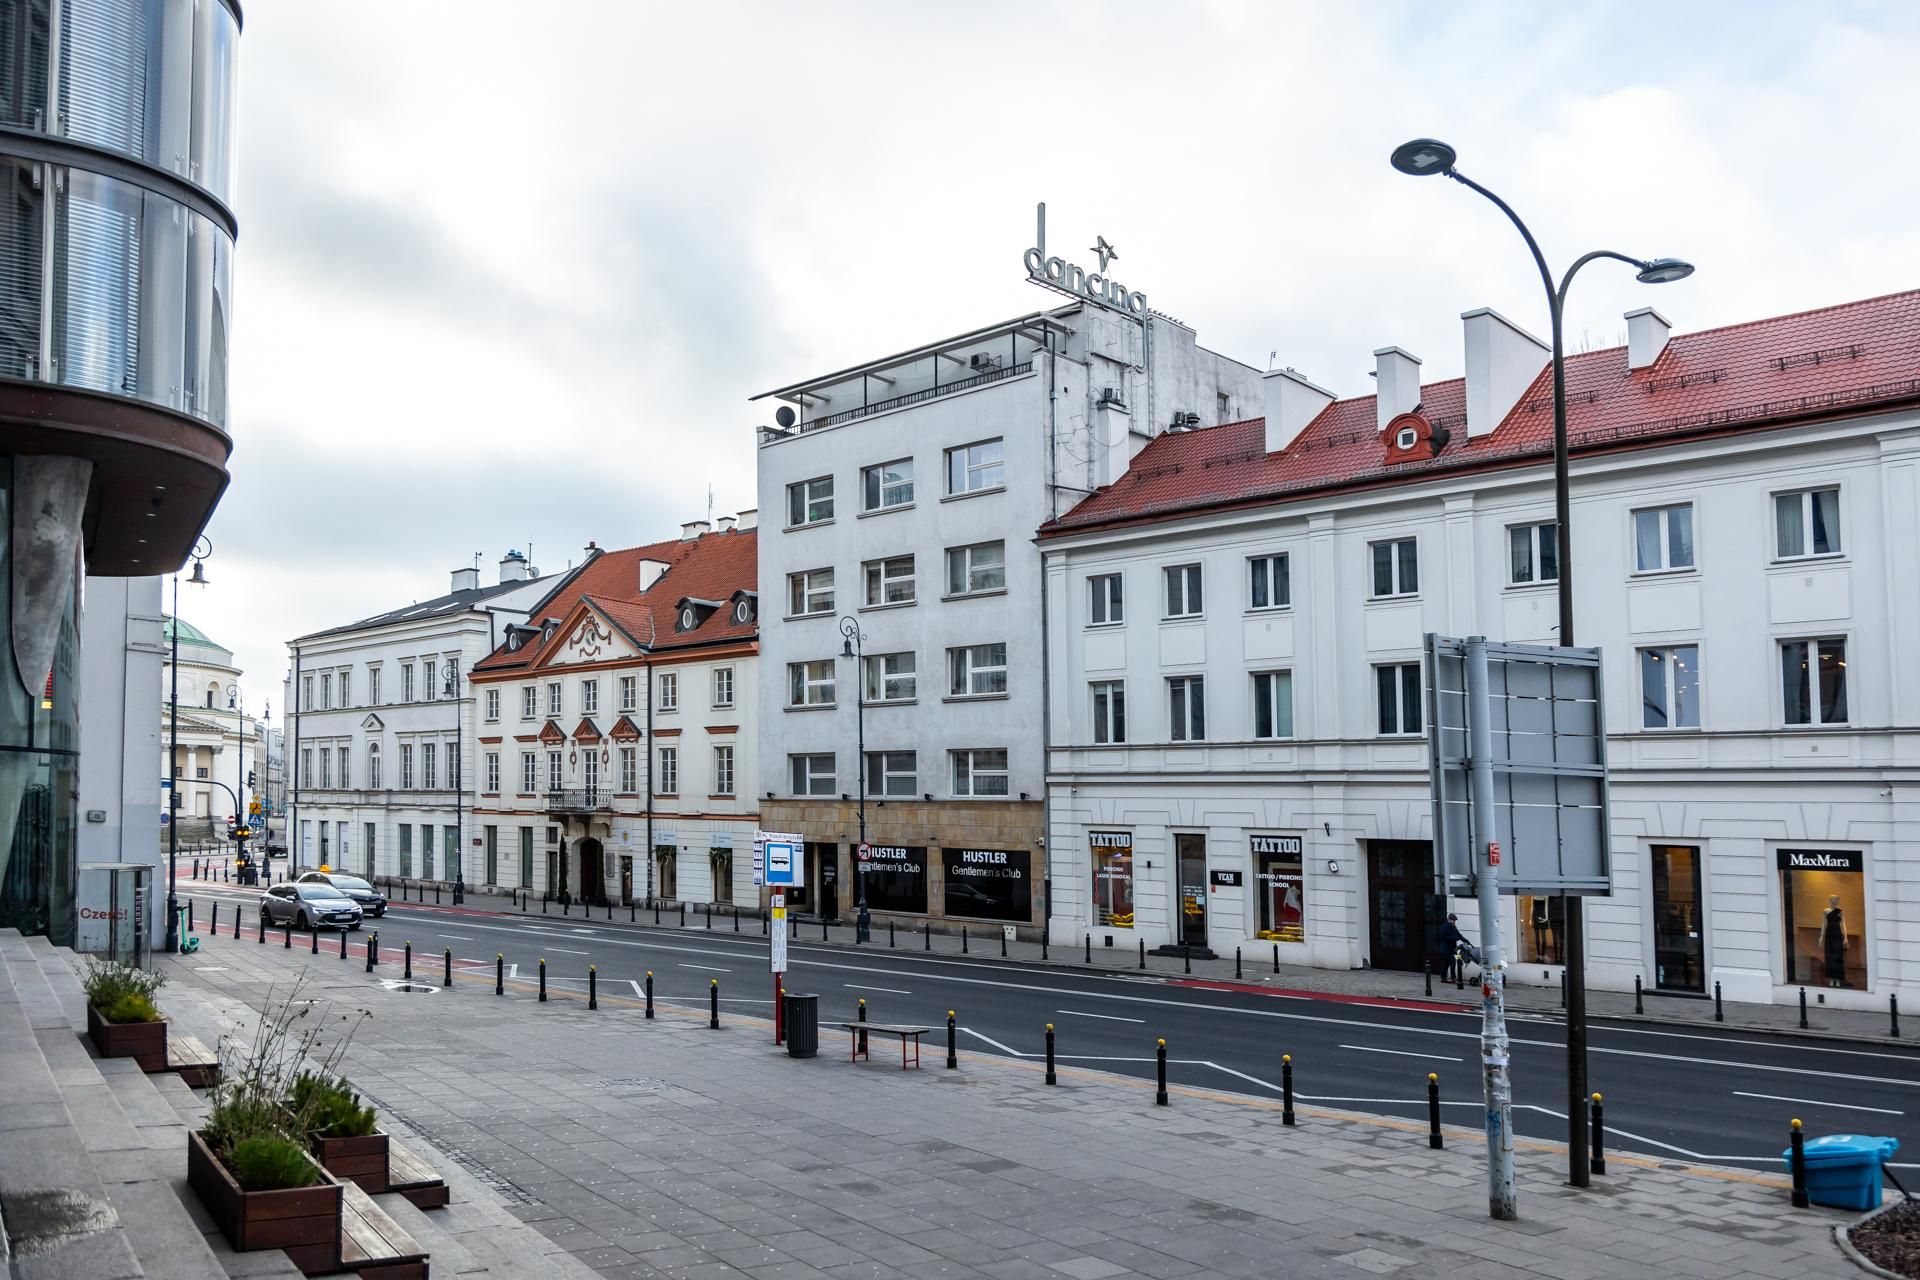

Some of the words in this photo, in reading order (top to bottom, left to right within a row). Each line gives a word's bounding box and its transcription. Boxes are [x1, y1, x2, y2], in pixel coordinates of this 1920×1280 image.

[1024, 202, 1148, 374] dancing
[1090, 833, 1131, 847] TATTOO
[1252, 837, 1300, 853] TATTOO
[963, 851, 1007, 864] HUSTLER
[1789, 853, 1850, 867] MaxMara
[903, 862, 921, 873] Club
[952, 865, 1000, 877] Gentlemen's
[1001, 868, 1021, 879] Club
